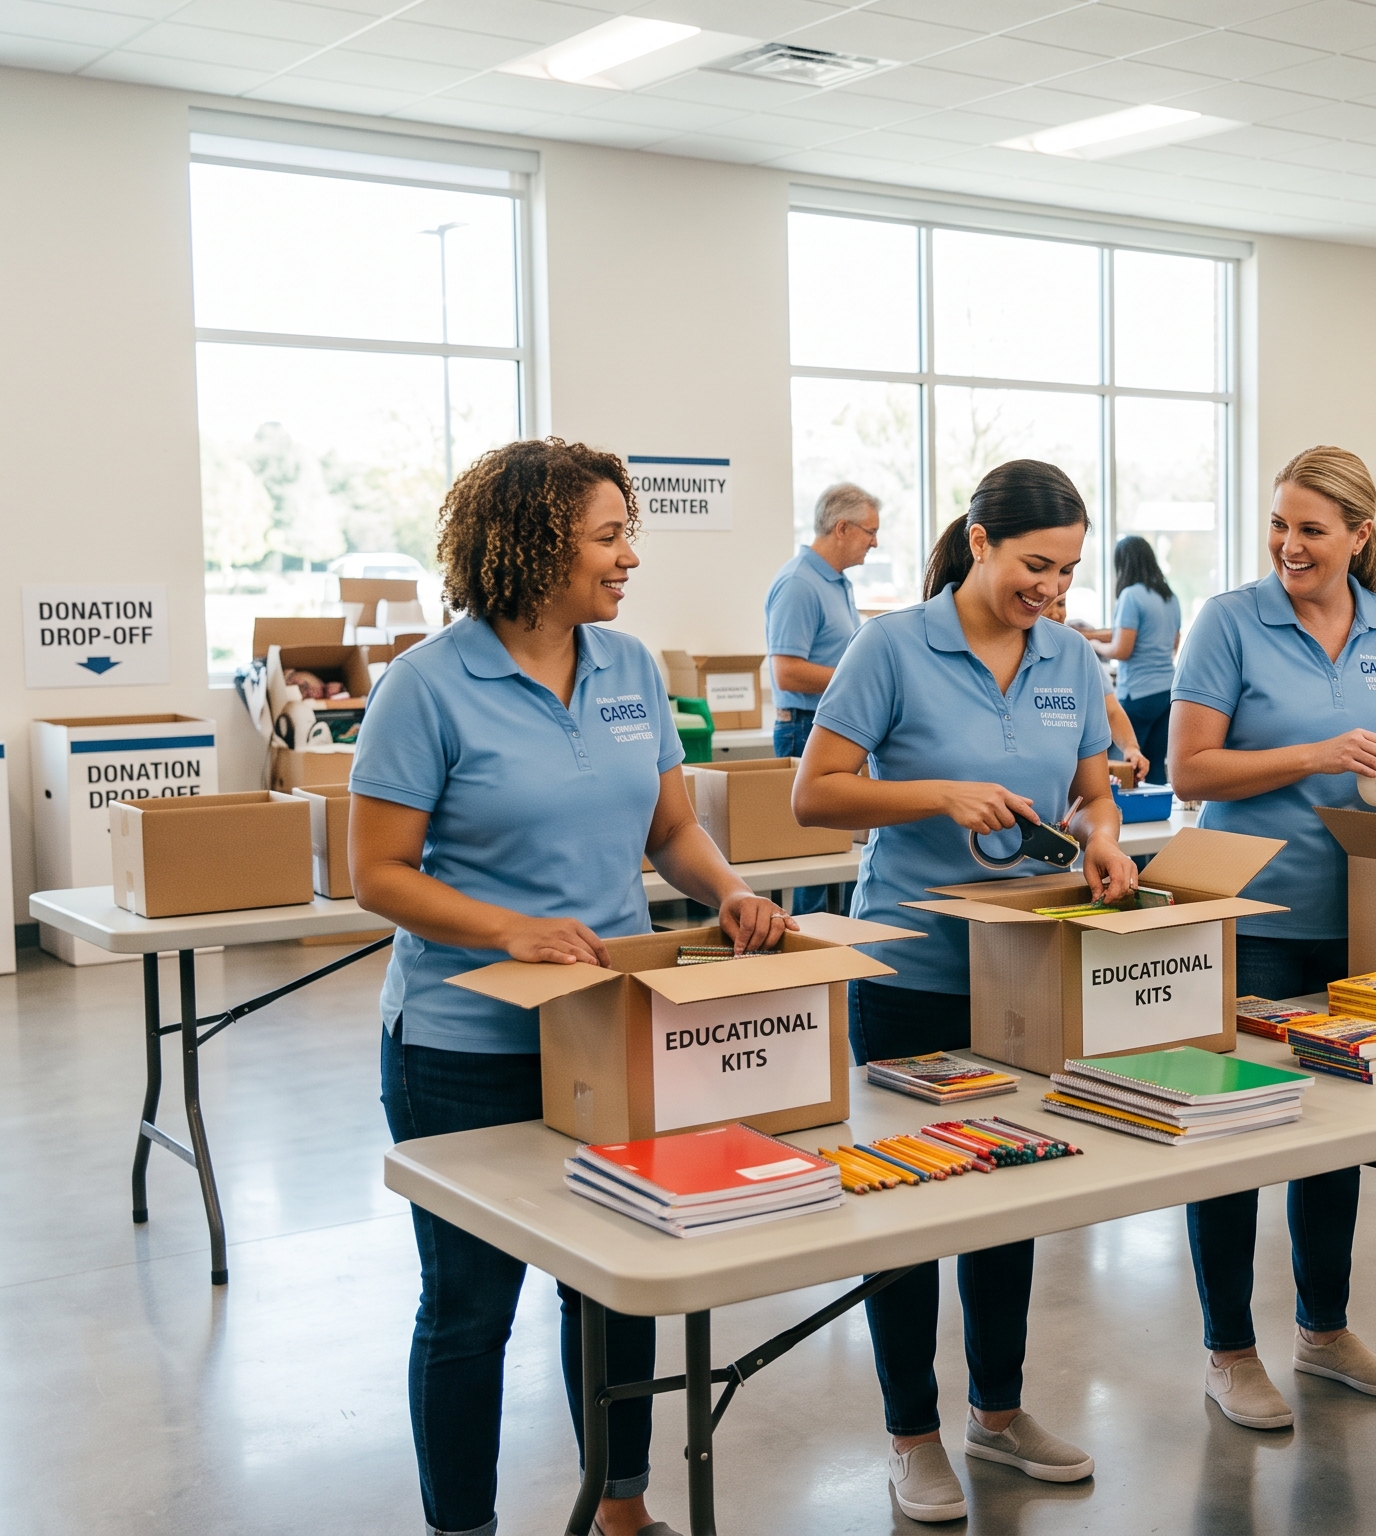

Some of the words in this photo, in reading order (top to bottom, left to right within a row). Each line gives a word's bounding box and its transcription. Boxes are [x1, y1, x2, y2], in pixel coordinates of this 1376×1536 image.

[631, 476, 726, 494] COMMUNITY
[649, 498, 709, 514] CENTER
[38, 601, 154, 621] DONATION
[40, 626, 154, 647] DROP-OFF
[600, 703, 647, 722] CARES
[1034, 695, 1076, 710] CARES
[87, 759, 201, 784] DONATION
[1091, 952, 1214, 988] EDUCATIONAL
[1134, 984, 1173, 1007] KITS
[665, 1012, 818, 1051] EDUCATIONAL
[720, 1048, 768, 1074] KITS
